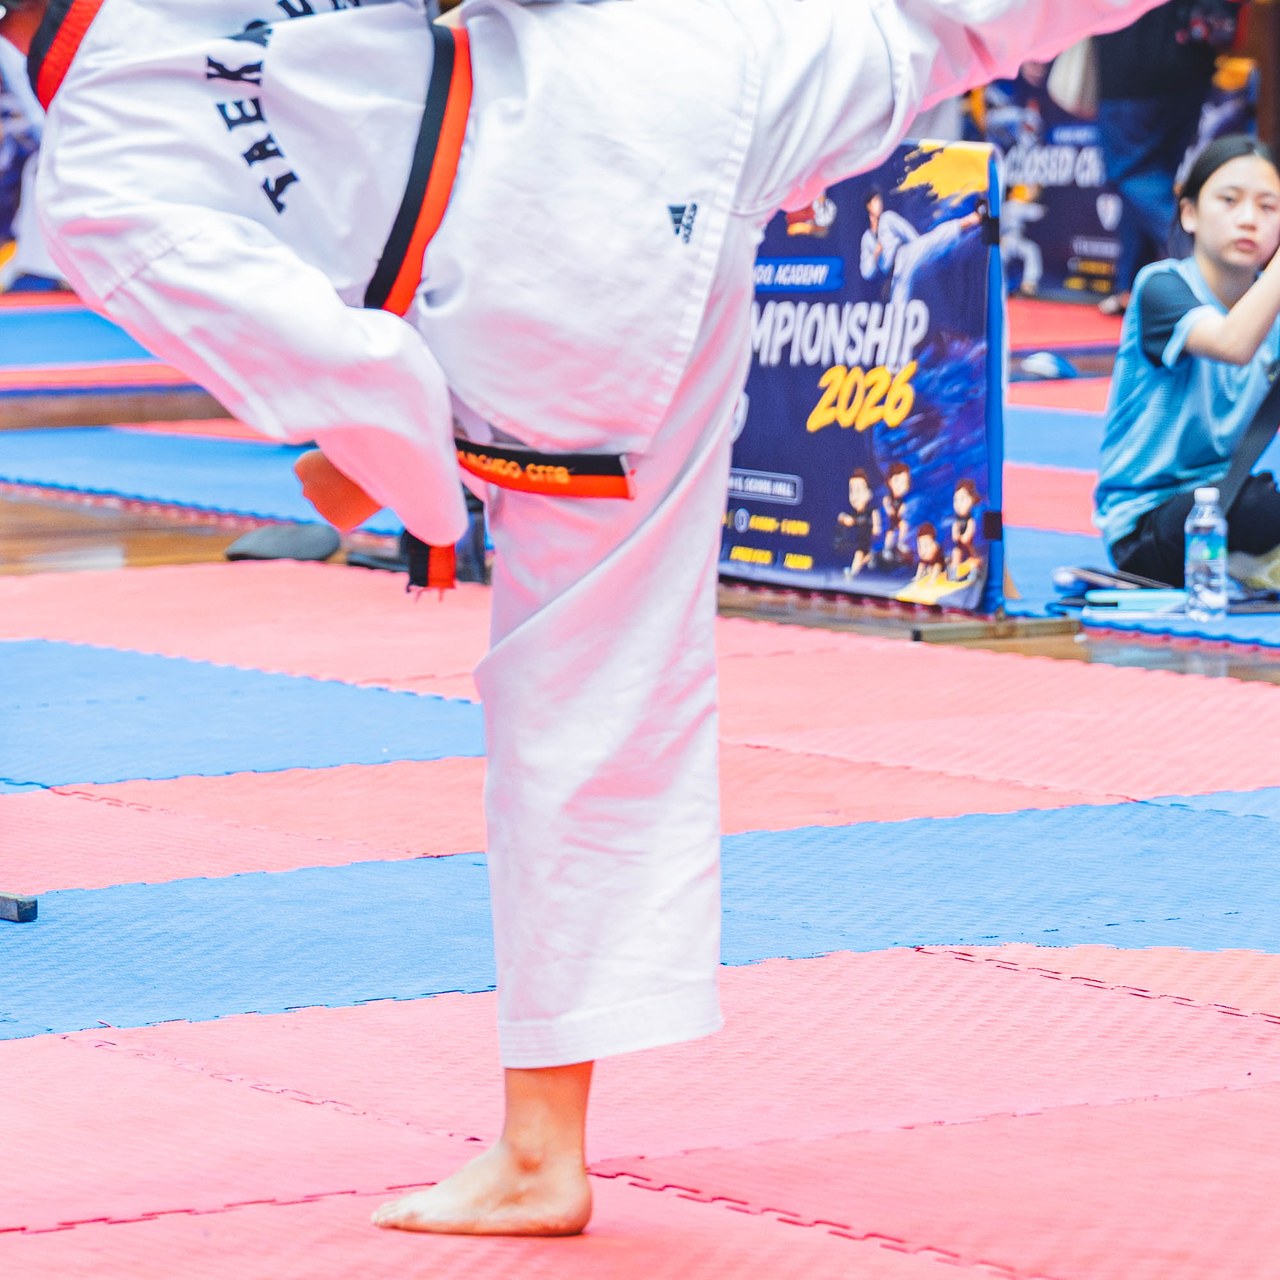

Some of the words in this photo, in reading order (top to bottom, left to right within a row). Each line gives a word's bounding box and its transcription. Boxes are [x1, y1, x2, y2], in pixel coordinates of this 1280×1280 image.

[774, 264, 830, 286] ACADEMY
[751, 299, 930, 367] MPIONSHIP
[806, 361, 917, 432] 2026
